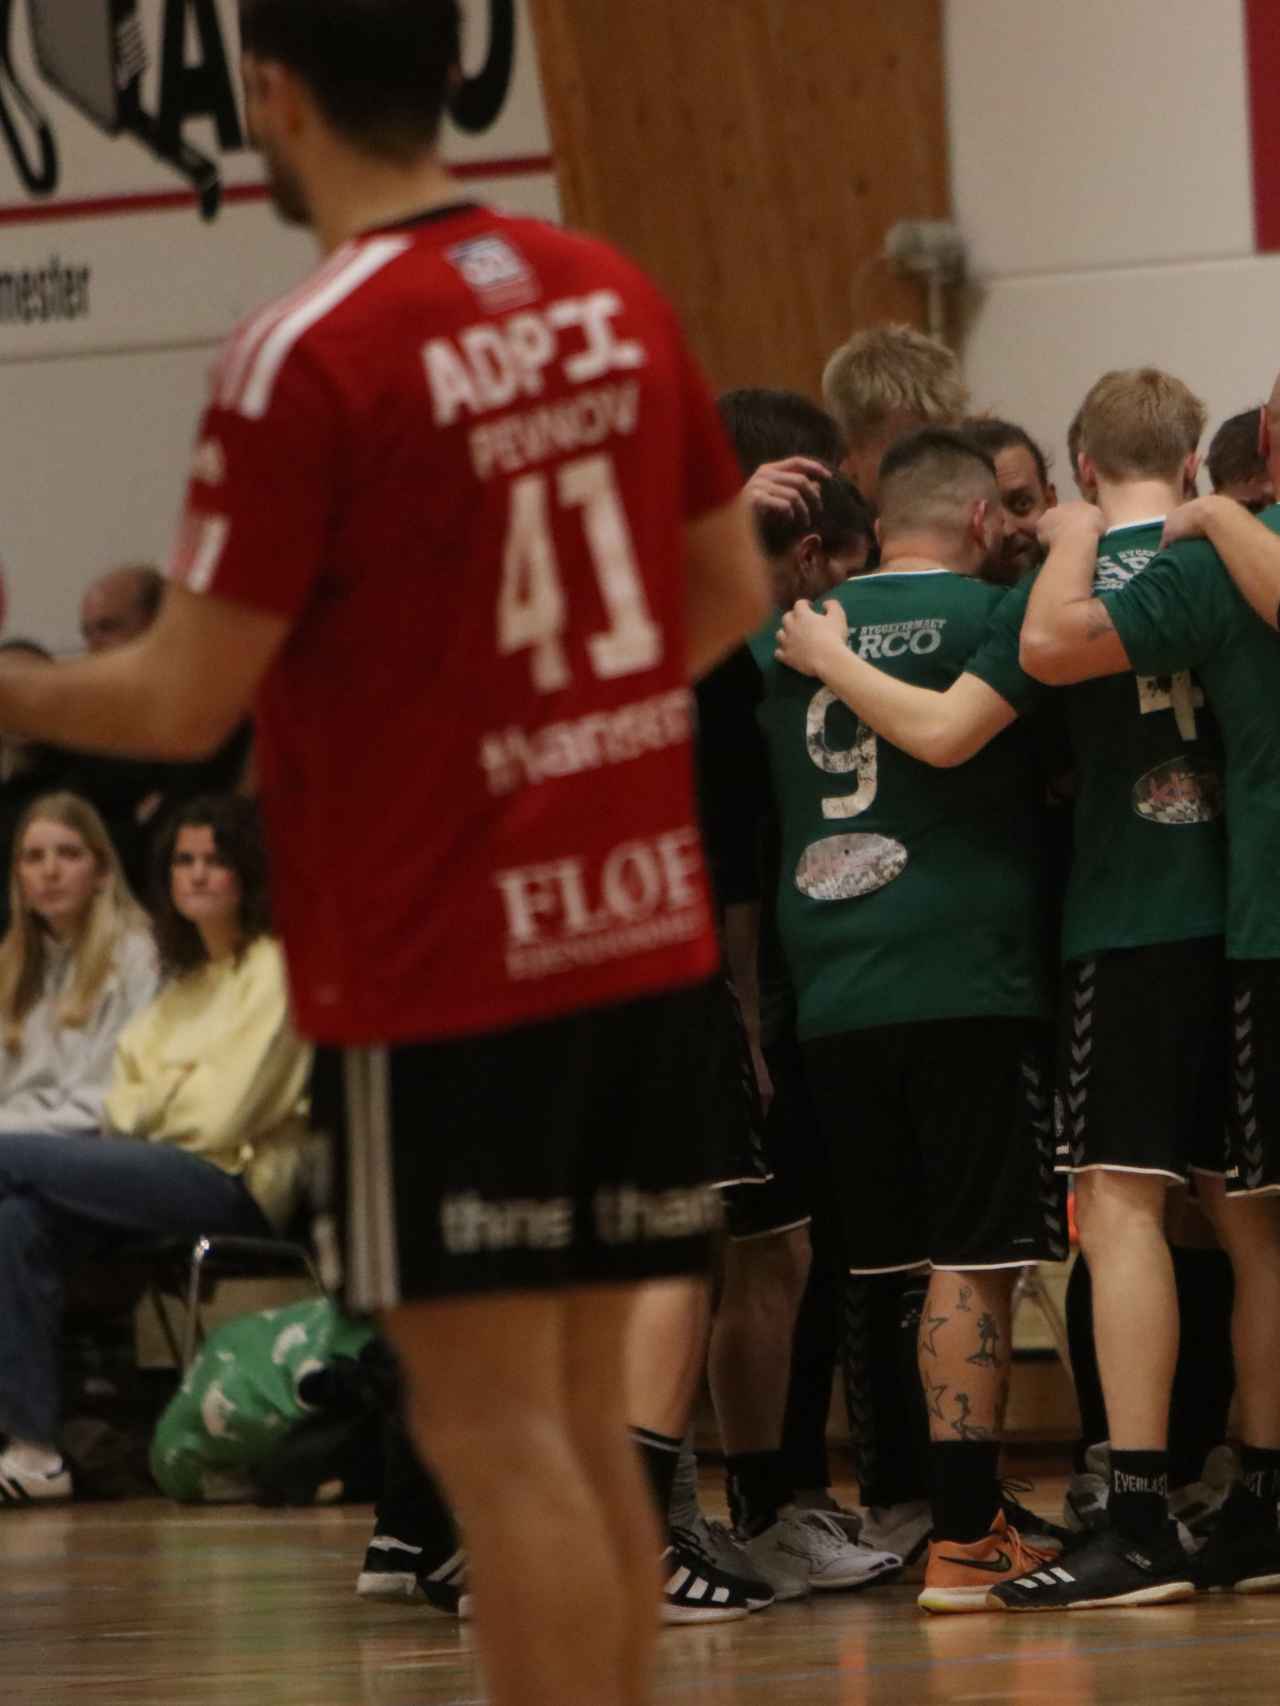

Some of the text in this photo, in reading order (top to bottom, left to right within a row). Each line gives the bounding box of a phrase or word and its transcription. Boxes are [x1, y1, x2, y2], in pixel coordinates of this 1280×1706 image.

[498, 454, 662, 692] 41
[847, 628, 942, 660] RCO
[806, 685, 880, 821] 9
